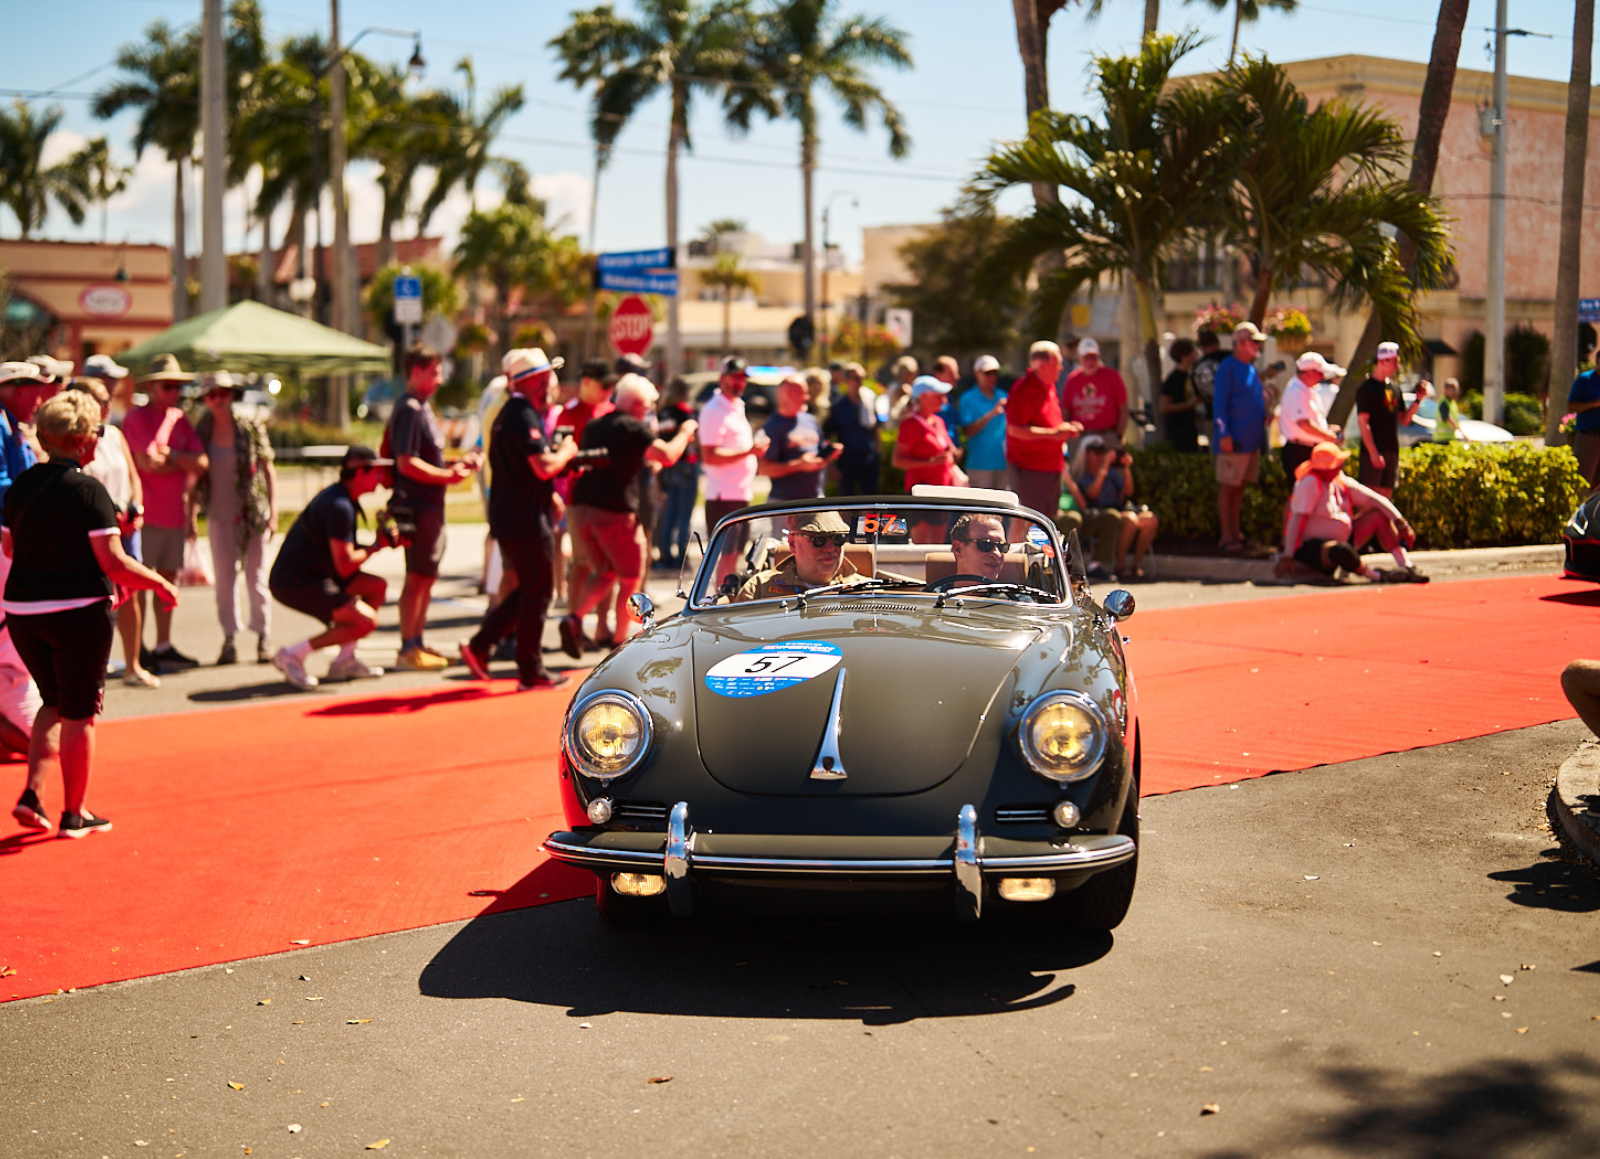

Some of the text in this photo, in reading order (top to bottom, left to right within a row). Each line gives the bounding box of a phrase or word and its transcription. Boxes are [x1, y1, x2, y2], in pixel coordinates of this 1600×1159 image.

[612, 313, 652, 340] STOP
[863, 513, 898, 533] 57
[744, 656, 808, 673] 57
